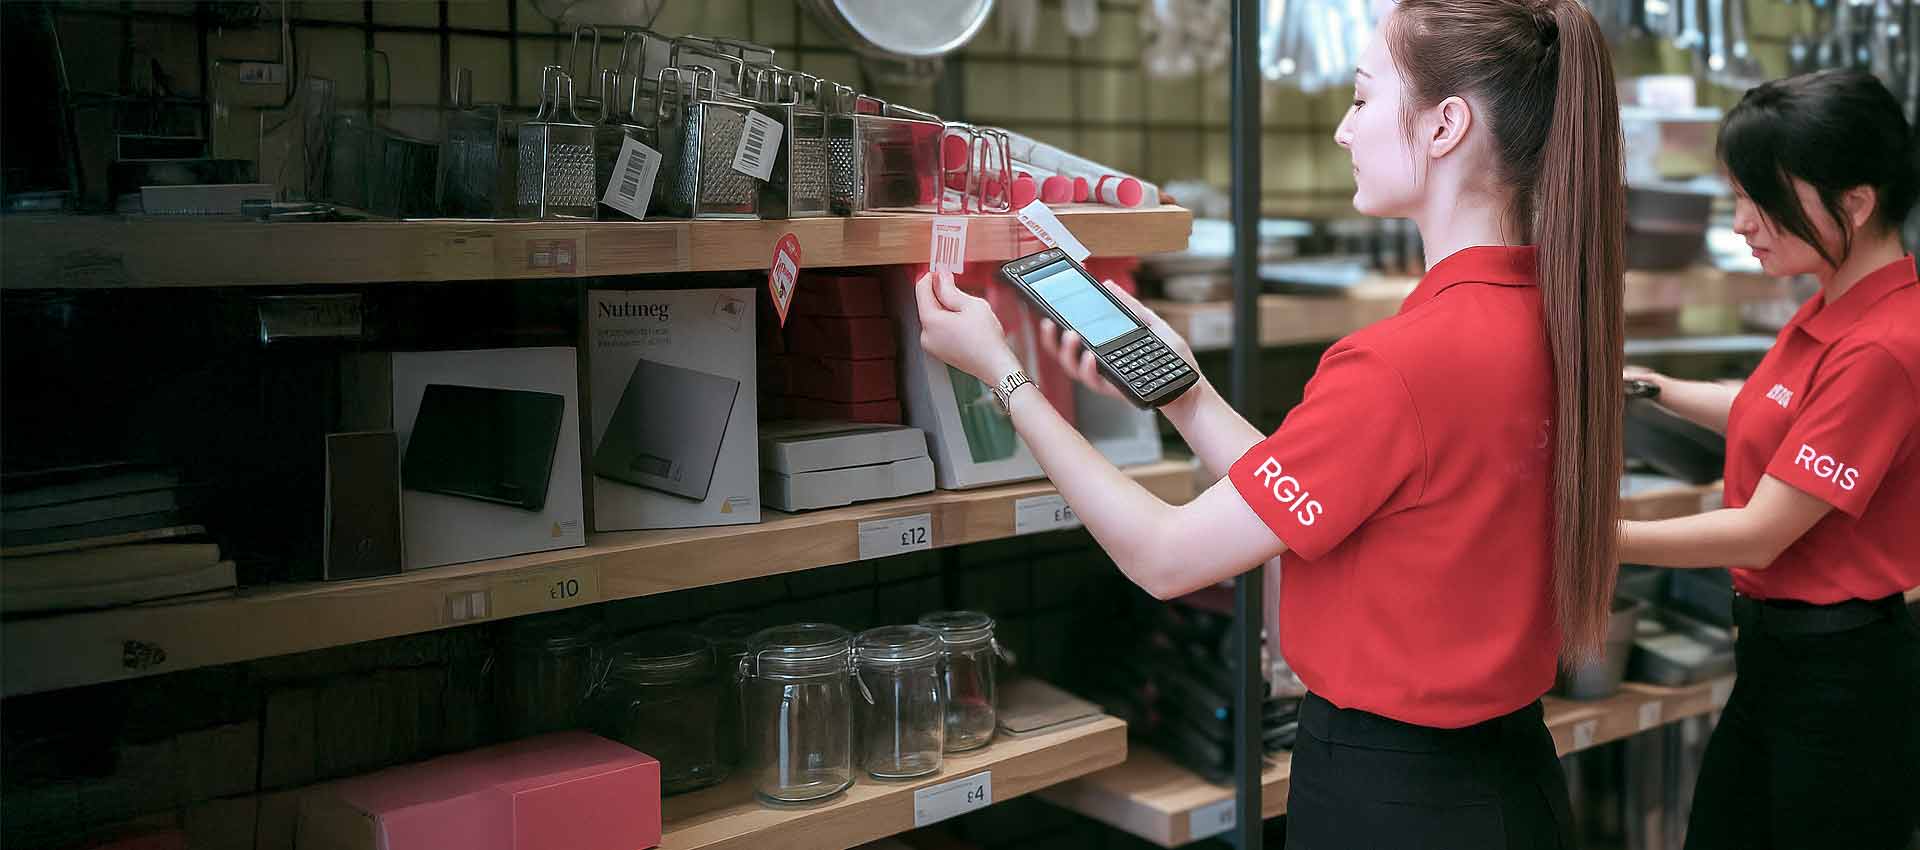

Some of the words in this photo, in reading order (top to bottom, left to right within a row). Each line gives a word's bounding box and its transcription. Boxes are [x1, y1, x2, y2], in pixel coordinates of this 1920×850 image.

[598, 300, 669, 321] Nutmeg
[1795, 443, 1859, 491] RGIS
[1253, 456, 1323, 526] RGIS
[901, 527, 926, 546] £12
[967, 785, 984, 803] £4
